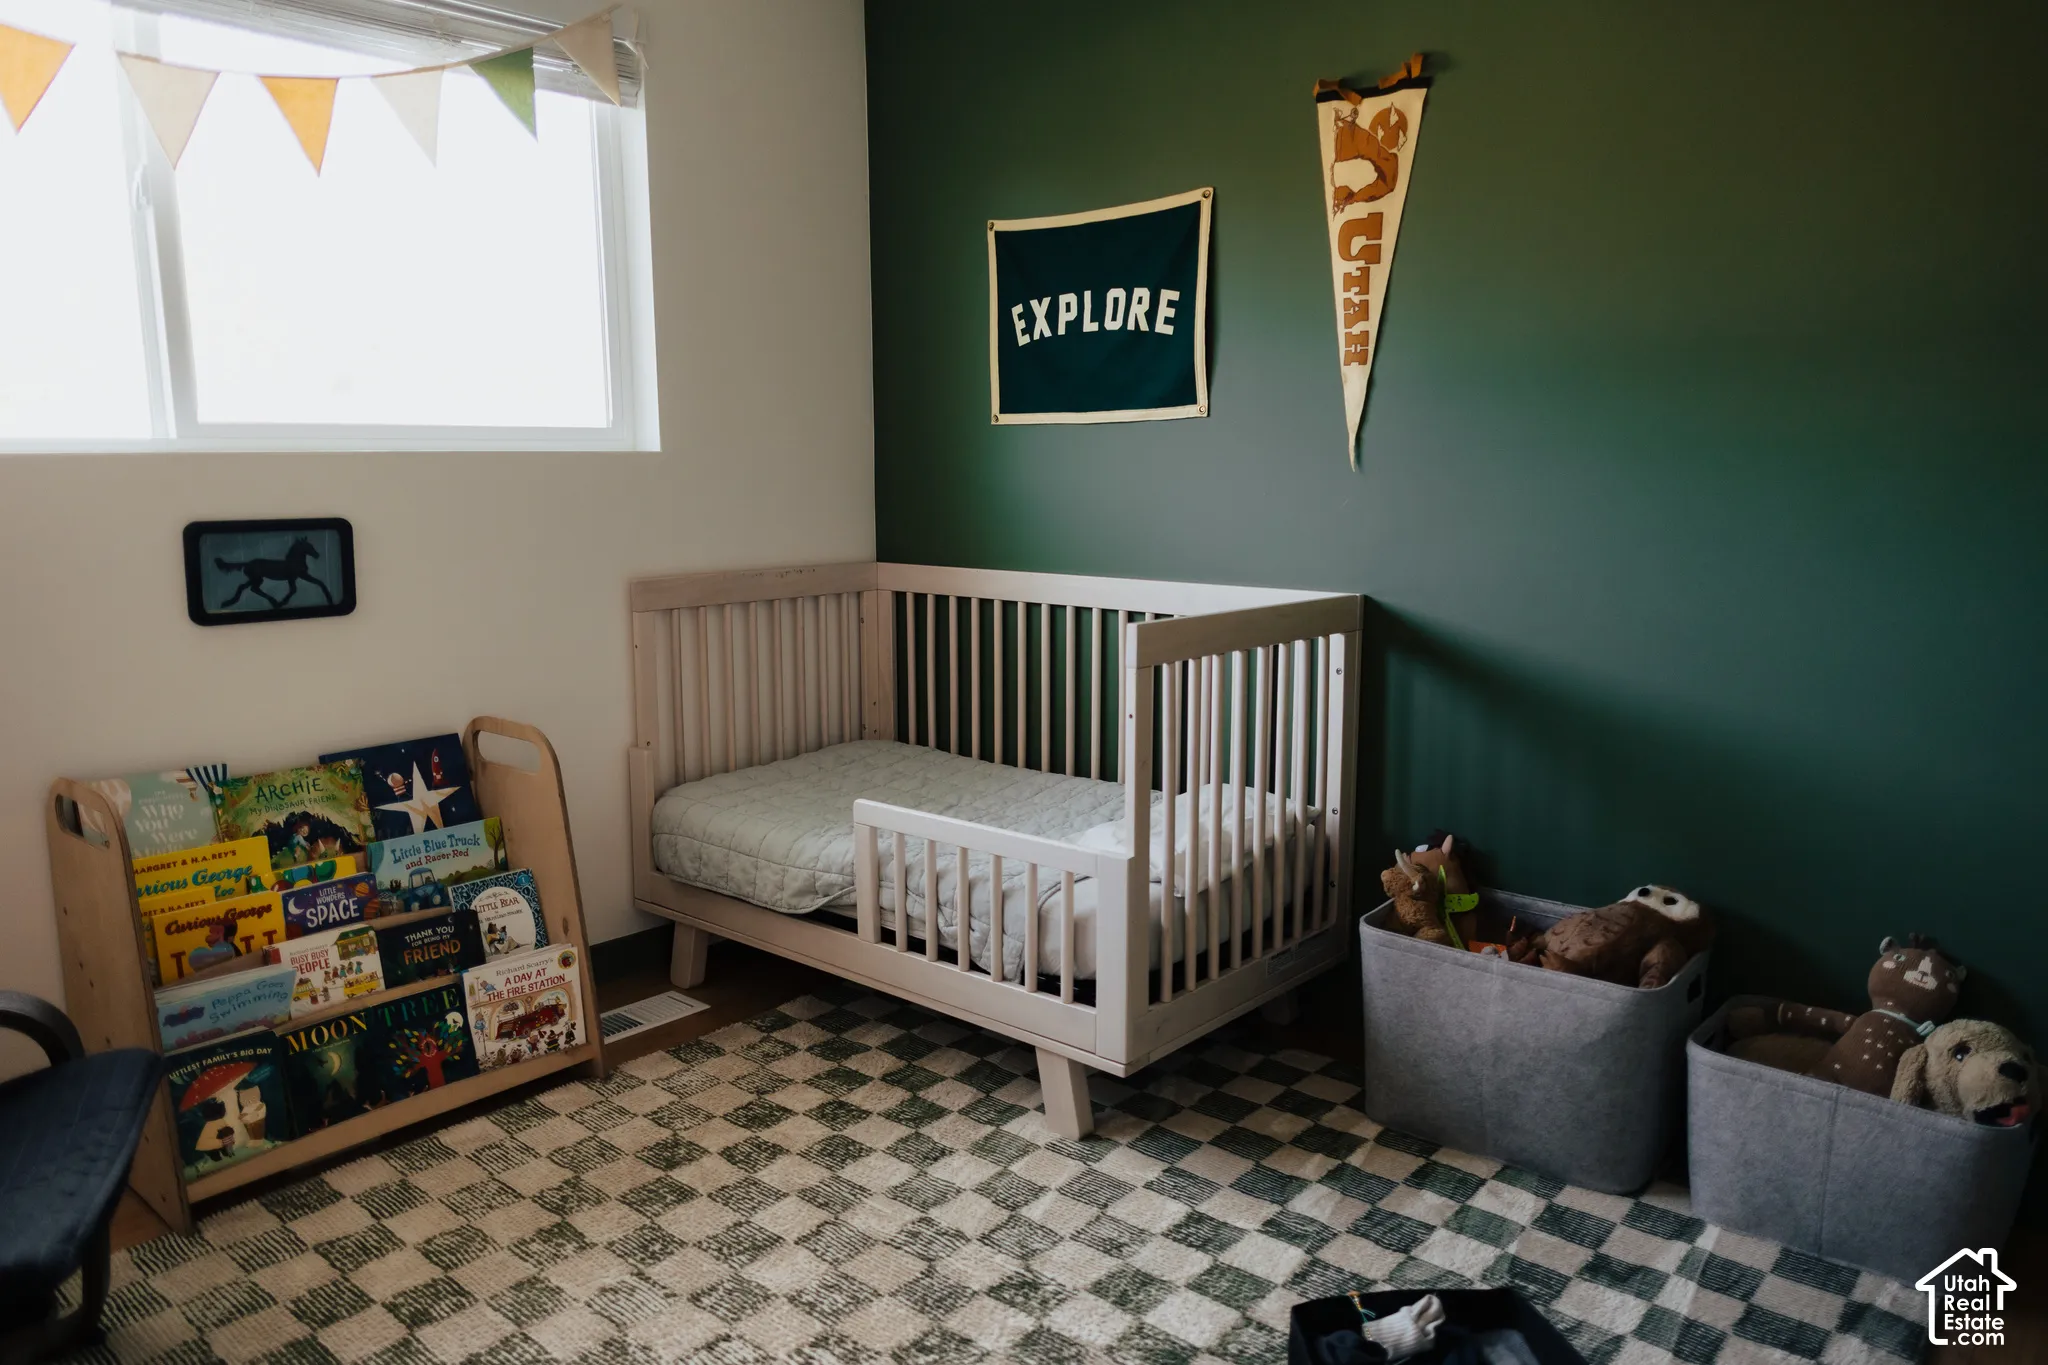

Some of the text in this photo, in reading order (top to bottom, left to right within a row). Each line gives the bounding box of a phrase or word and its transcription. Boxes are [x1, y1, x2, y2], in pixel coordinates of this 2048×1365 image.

[1338, 212, 1383, 366] UTAH
[1011, 287, 1180, 347] EXPLORE
[265, 799, 307, 813] DINOSAUR
[390, 833, 480, 865] Little Blue Truck
[405, 848, 469, 870] and Racer Red
[192, 865, 253, 886] George
[316, 892, 346, 905] WONDERS
[474, 896, 520, 914] LITTLE BEAR
[223, 903, 273, 919] George
[306, 897, 360, 928] SPACE
[405, 926, 454, 943] THANK YOU
[424, 936, 440, 944] BEING
[290, 948, 329, 966] BUSY BUSY
[403, 940, 461, 966] FRIEND
[496, 958, 553, 977] Richard Scarry's
[504, 967, 547, 987] A DAY AT
[212, 980, 285, 1010] Peppa Goes
[486, 990, 504, 1002] THE
[377, 988, 461, 1028] TREE
[284, 1012, 369, 1056] MOON
[168, 1047, 273, 1080] LITTLEST FAMILY'S BIG DAY
